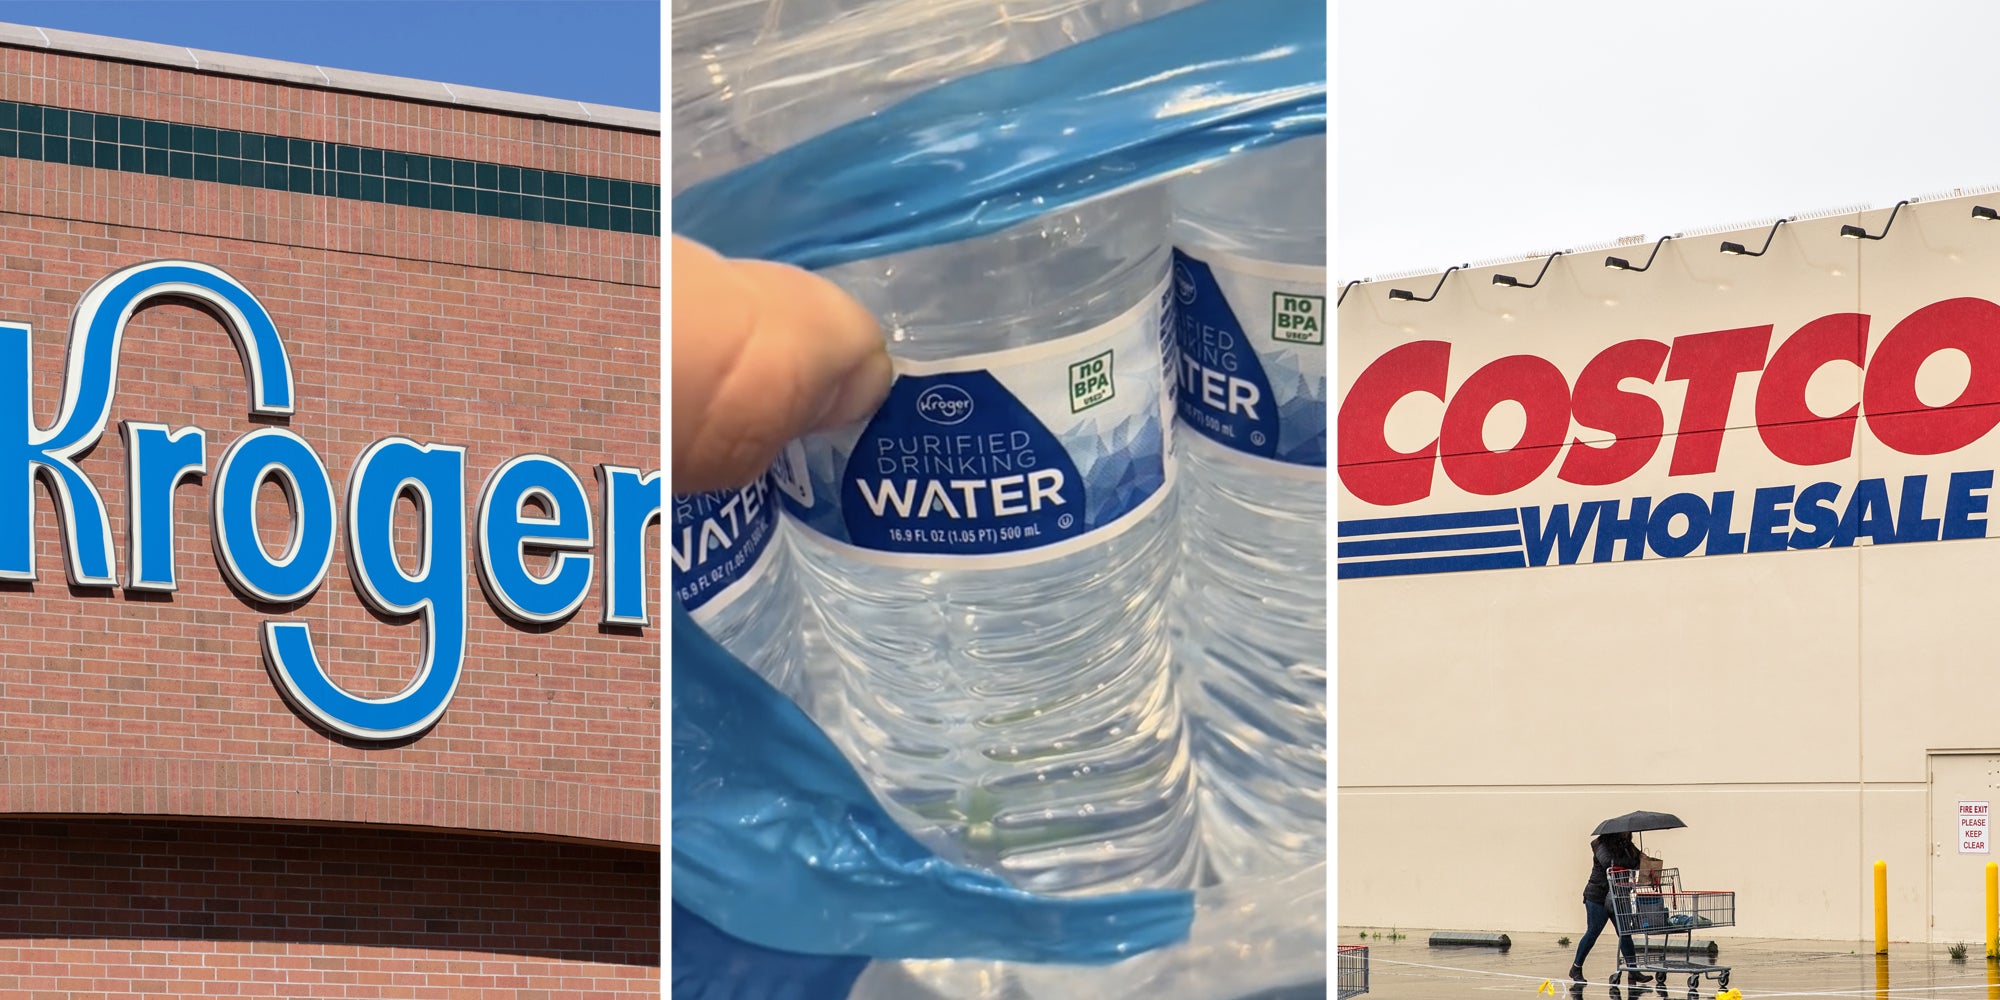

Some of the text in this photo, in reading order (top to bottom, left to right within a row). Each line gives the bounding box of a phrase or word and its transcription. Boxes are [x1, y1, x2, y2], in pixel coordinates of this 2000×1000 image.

[1283, 298, 1312, 313] no
[1278, 313, 1318, 332] BPA
[1080, 359, 1103, 379] no
[1074, 372, 1109, 399] BPA
[920, 393, 970, 417] Kroger
[1338, 297, 2000, 506] COSTCO
[877, 430, 1031, 456] PURIFIED
[877, 450, 1037, 475] DRINKING
[0, 259, 661, 742] Kroger
[855, 468, 1067, 519] WATER
[1517, 469, 1994, 568] WHOLESALE
[889, 523, 1041, 545] 16.9 FL OZ (1.05 PT) 500 mL
[698, 574, 712, 593] FL
[710, 565, 725, 583] OZ
[1959, 805, 1988, 814] FIRE EXIT
[1961, 818, 1986, 827] PLEASE
[1965, 830, 1983, 838] KEEP
[1963, 841, 1985, 849] CLEAR
